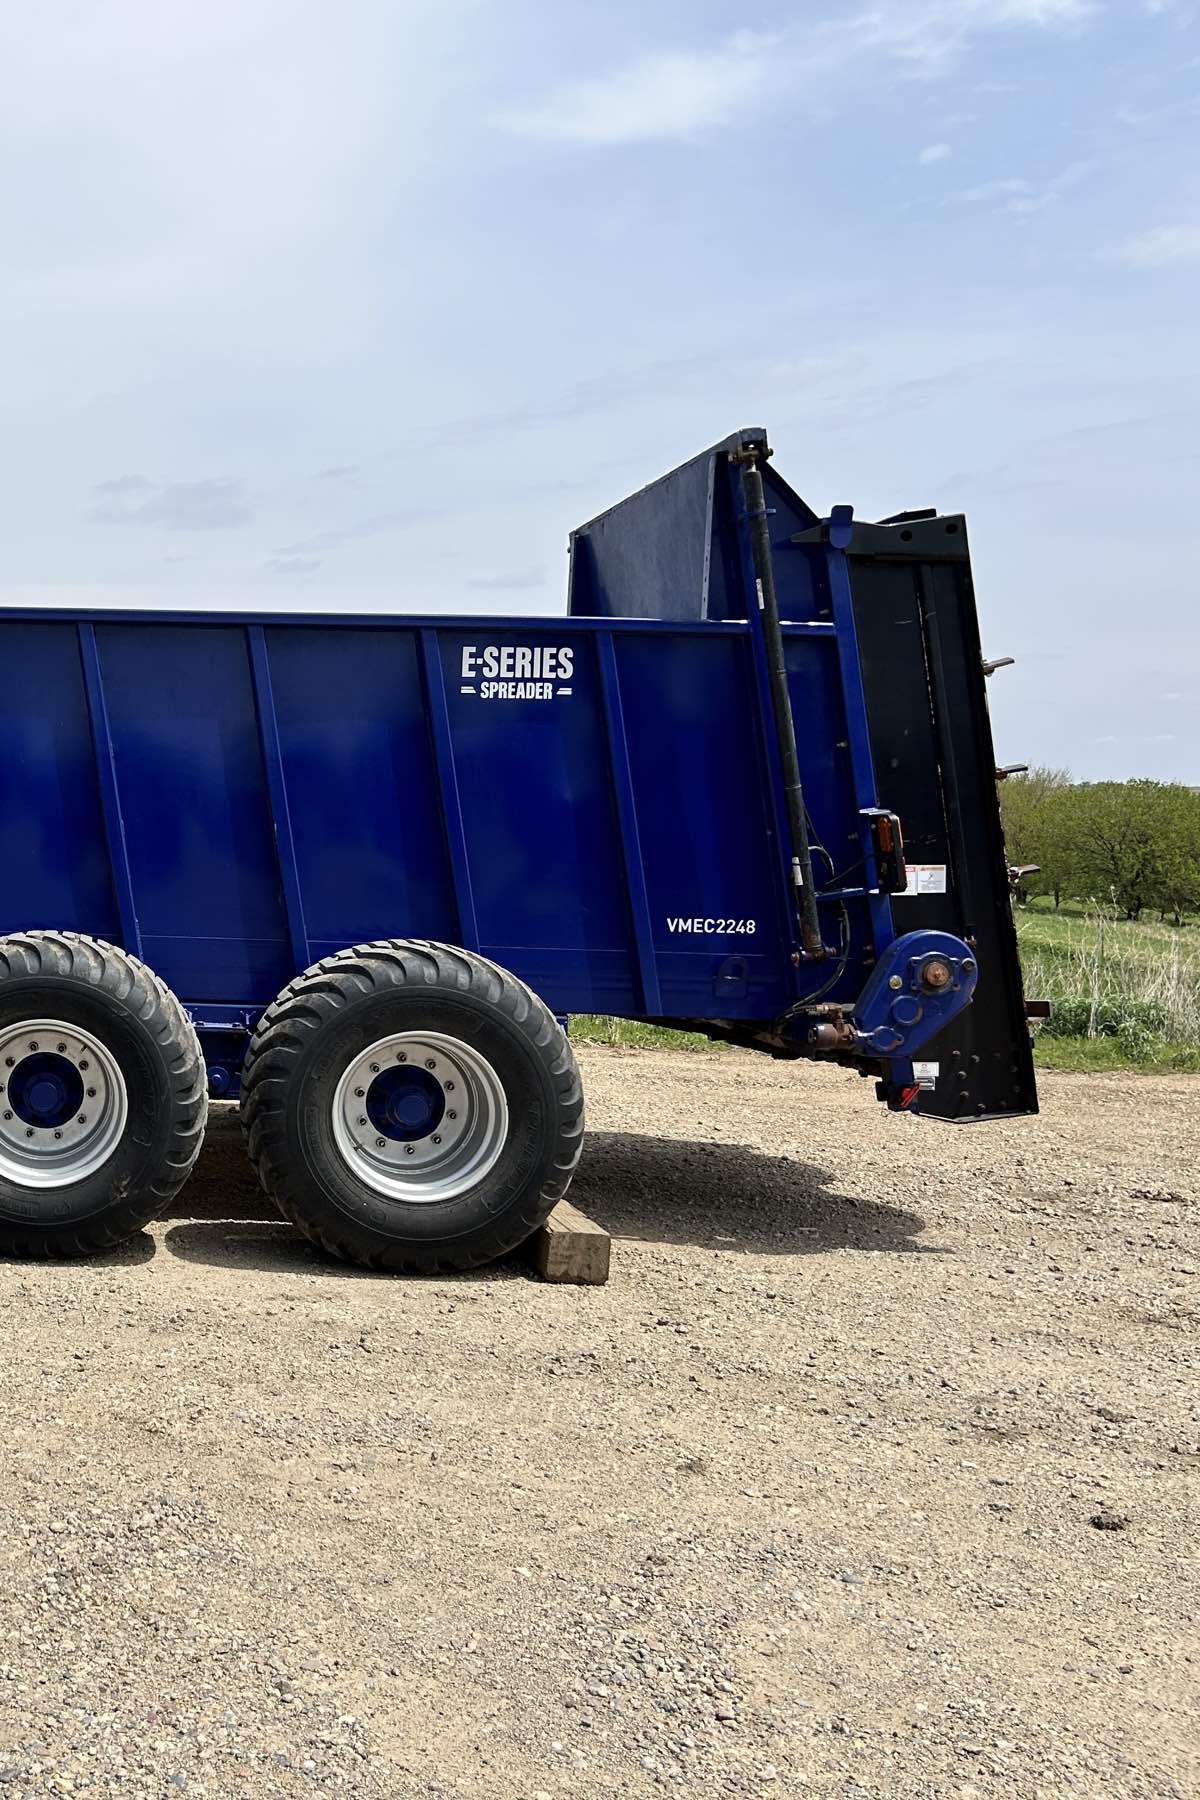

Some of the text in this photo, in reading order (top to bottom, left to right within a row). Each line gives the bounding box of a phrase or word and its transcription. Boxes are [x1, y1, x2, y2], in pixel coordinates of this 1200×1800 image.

[461, 646, 574, 679] E-SERIES
[480, 681, 553, 699] SPREADER
[666, 917, 756, 934] VMEC2248
